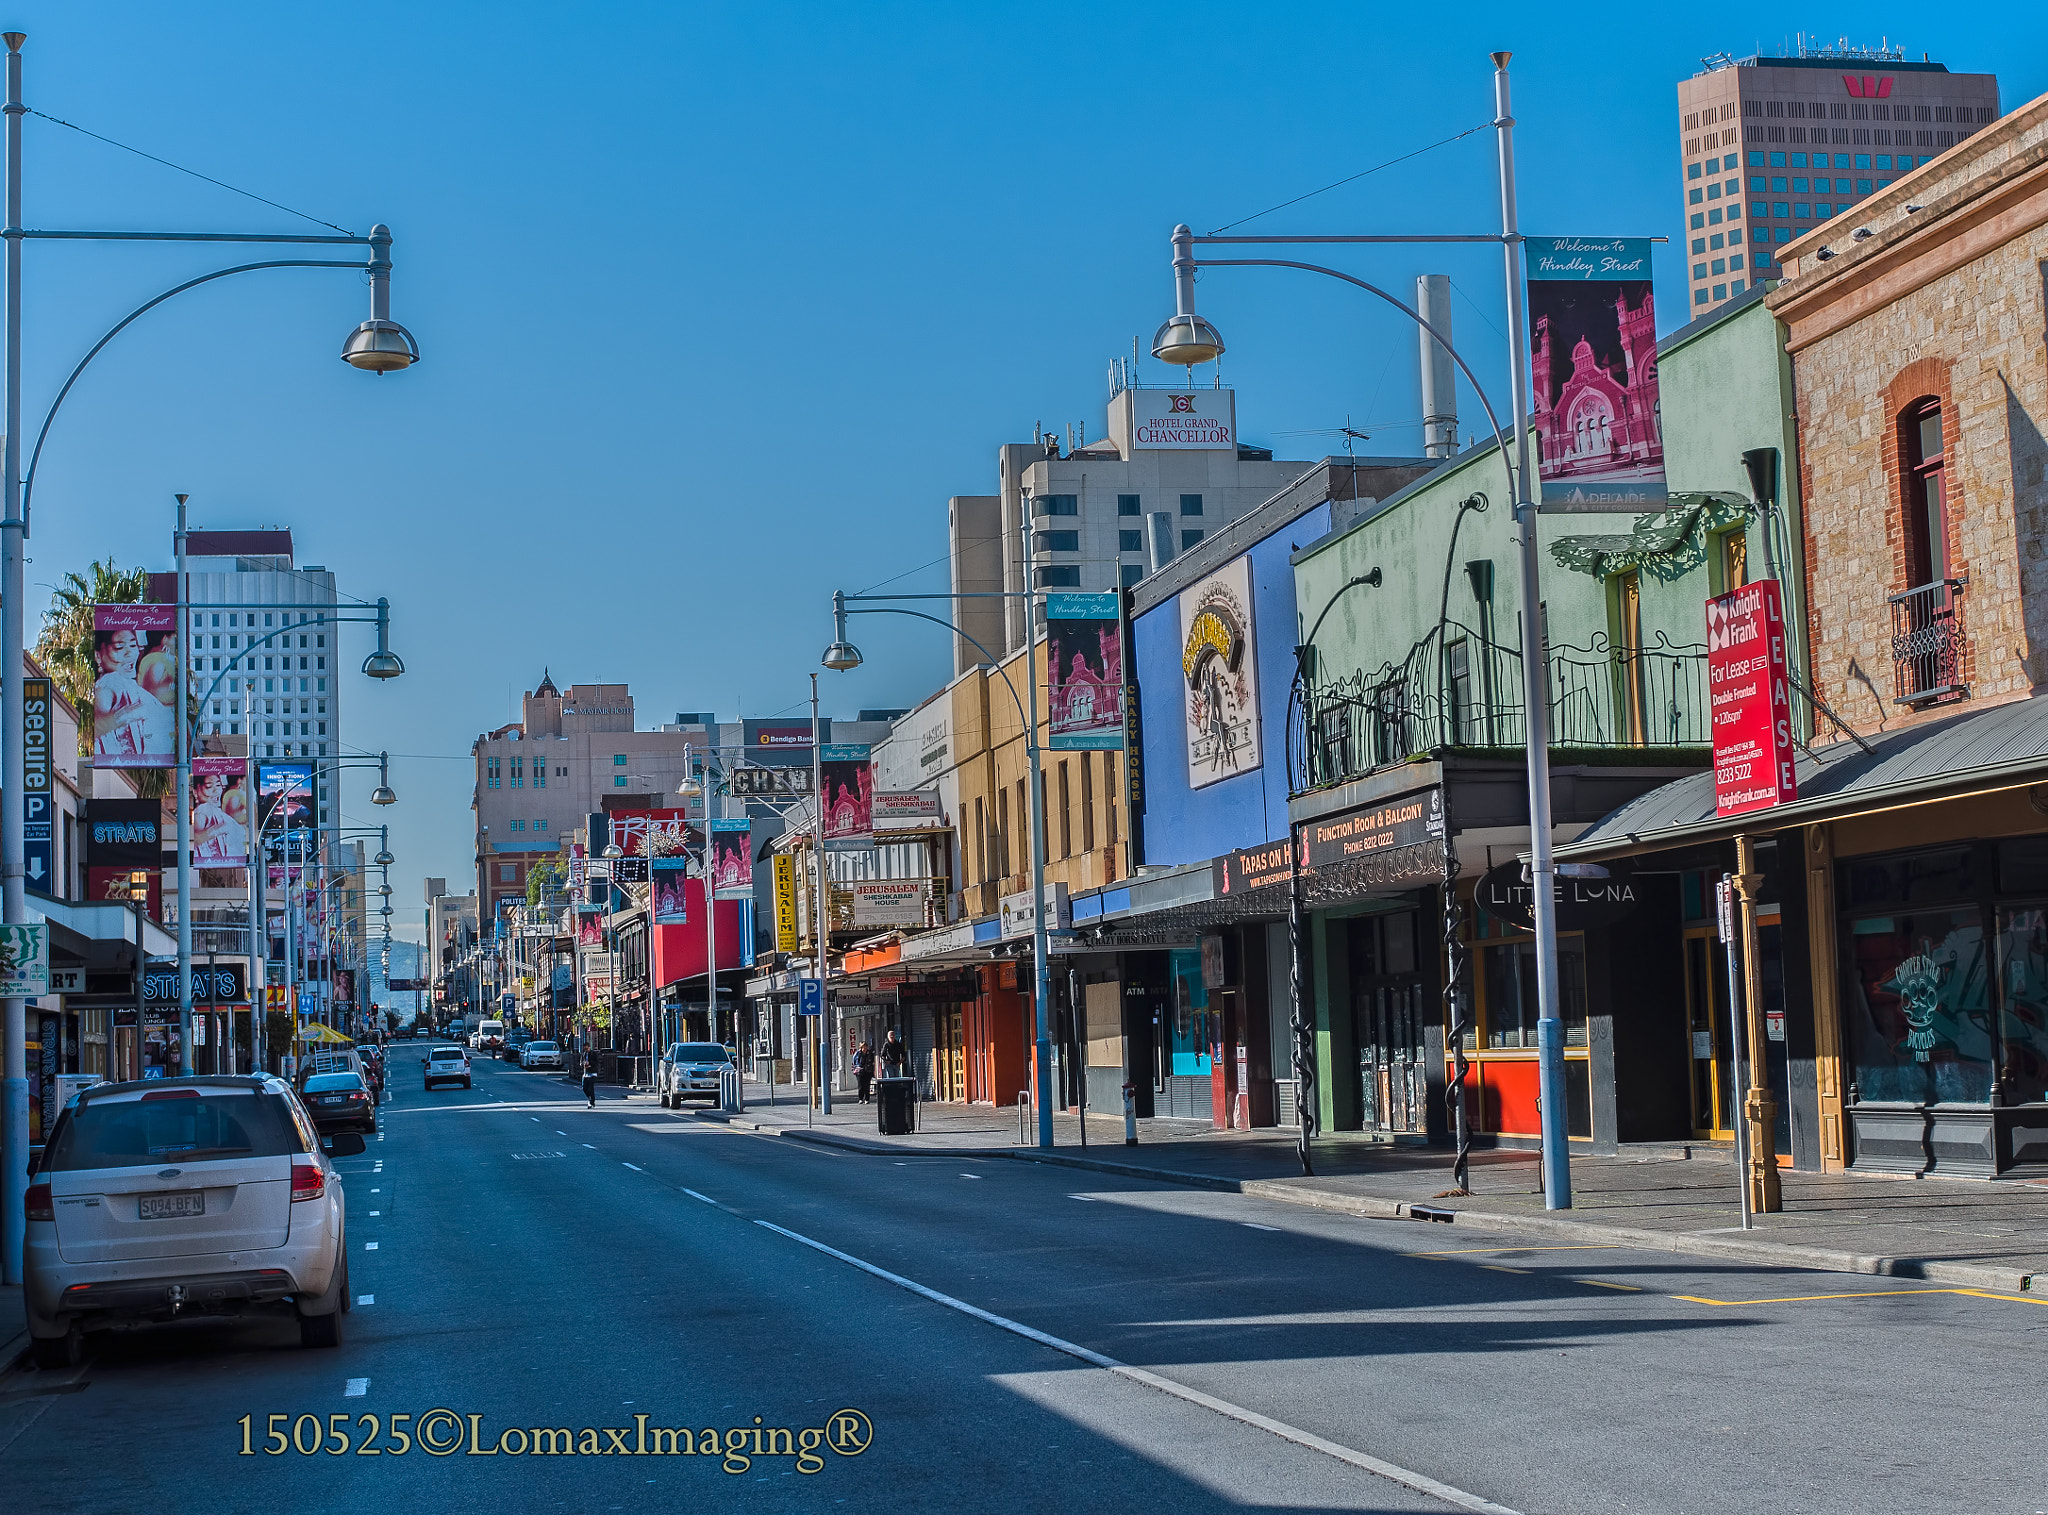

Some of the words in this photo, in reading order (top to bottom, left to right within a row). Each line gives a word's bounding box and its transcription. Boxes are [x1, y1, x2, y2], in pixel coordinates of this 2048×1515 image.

[1552, 239, 1610, 253] Welcome
[1612, 239, 1625, 253] to
[1539, 256, 1595, 278] Hindley
[1600, 256, 1643, 273] Street
[1149, 418, 1183, 429] HOTEL
[1184, 418, 1219, 429] GRAND
[1137, 426, 1231, 444] CHANCELLOR
[1062, 593, 1100, 604] Welcome
[1100, 594, 1107, 603] to
[1729, 588, 1761, 620] Knight
[111, 603, 149, 613] Welcome
[1054, 605, 1088, 617] Hindley
[1090, 604, 1116, 615] Street
[103, 615, 140, 630] Hindley
[142, 615, 171, 627] Street
[1730, 617, 1759, 646] Frank
[1710, 664, 1725, 685] For
[1725, 658, 1750, 680] Lease
[1767, 594, 1793, 790] LEASE
[579, 706, 609, 715] MAYFAIR
[610, 706, 632, 715] HOTEL
[1126, 685, 1138, 740] CRAZY
[24, 700, 46, 788] secure
[770, 735, 797, 744] Bendigo
[826, 751, 849, 761] Hindley
[850, 751, 868, 760] Street
[198, 765, 222, 776] Hindley
[224, 765, 243, 773] Street
[1129, 747, 1141, 801] HORSE
[1717, 766, 1734, 786] 8233
[1735, 762, 1752, 782] 5222
[875, 795, 920, 803] JERUSALEM
[885, 800, 936, 808] SHESHKABAB
[28, 797, 45, 818] P
[1316, 823, 1353, 844] FUNCTION
[1353, 815, 1376, 834] ROOM
[1376, 811, 1384, 828] &
[1385, 803, 1423, 826] BALCONY
[93, 822, 157, 843] STRATS
[1343, 840, 1364, 856] PHONE
[1363, 834, 1377, 851] 8212
[1378, 831, 1394, 847] 0222
[1240, 852, 1267, 876] TAPAS
[1268, 848, 1282, 868] ON
[778, 858, 793, 932] JERUSALEM
[856, 884, 919, 895] JERUSALEM
[863, 893, 913, 901] SHESHKABAB
[501, 898, 527, 906] POLITES
[1090, 936, 1115, 946] CRAZY
[1116, 935, 1138, 945] HORSE
[804, 982, 818, 1000] P
[1126, 987, 1145, 996] ATM
[505, 999, 513, 1008] P
[1907, 1027, 1937, 1050] BICYCLES
